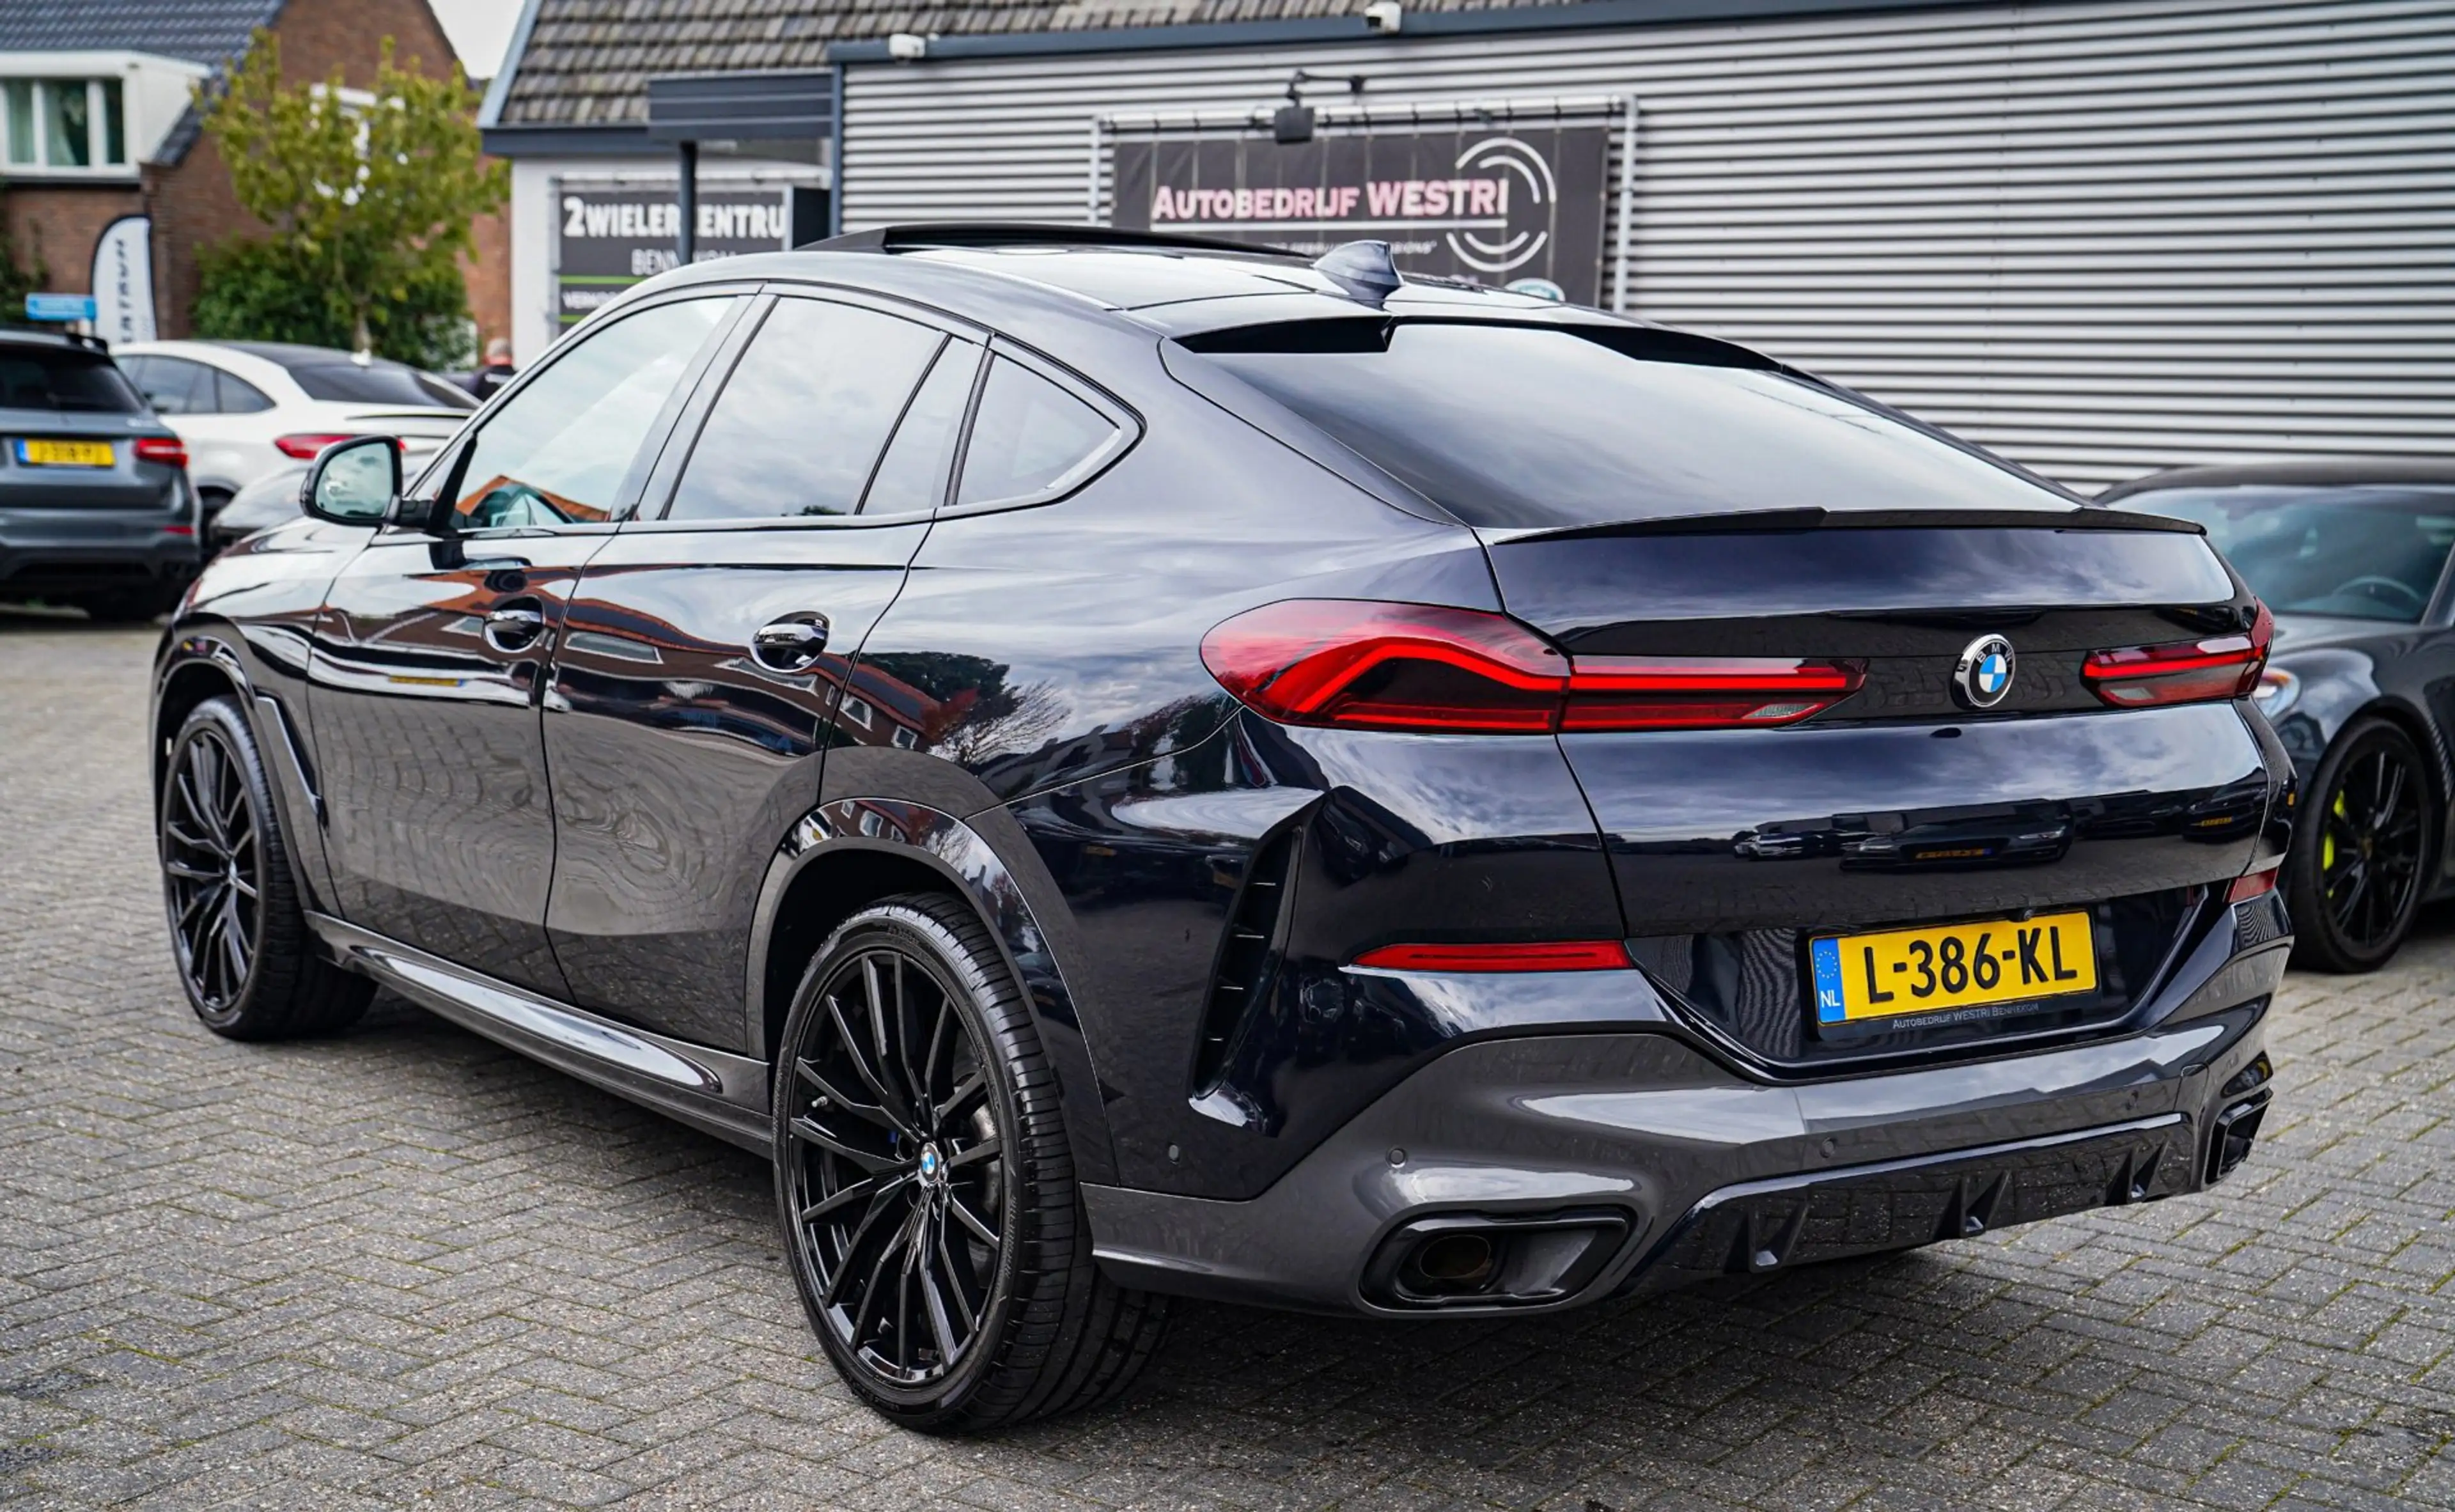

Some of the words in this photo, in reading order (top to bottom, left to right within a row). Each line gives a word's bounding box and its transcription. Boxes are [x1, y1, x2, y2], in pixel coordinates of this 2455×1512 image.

[1153, 185, 1359, 219] AUTOBEDRIJF
[1366, 178, 1508, 215] WESTRI
[1976, 643, 2014, 663] BMW
[1864, 926, 2077, 1004] L-386-KL
[1820, 990, 1841, 1009] NL
[1953, 1008, 1990, 1020] WESTRI
